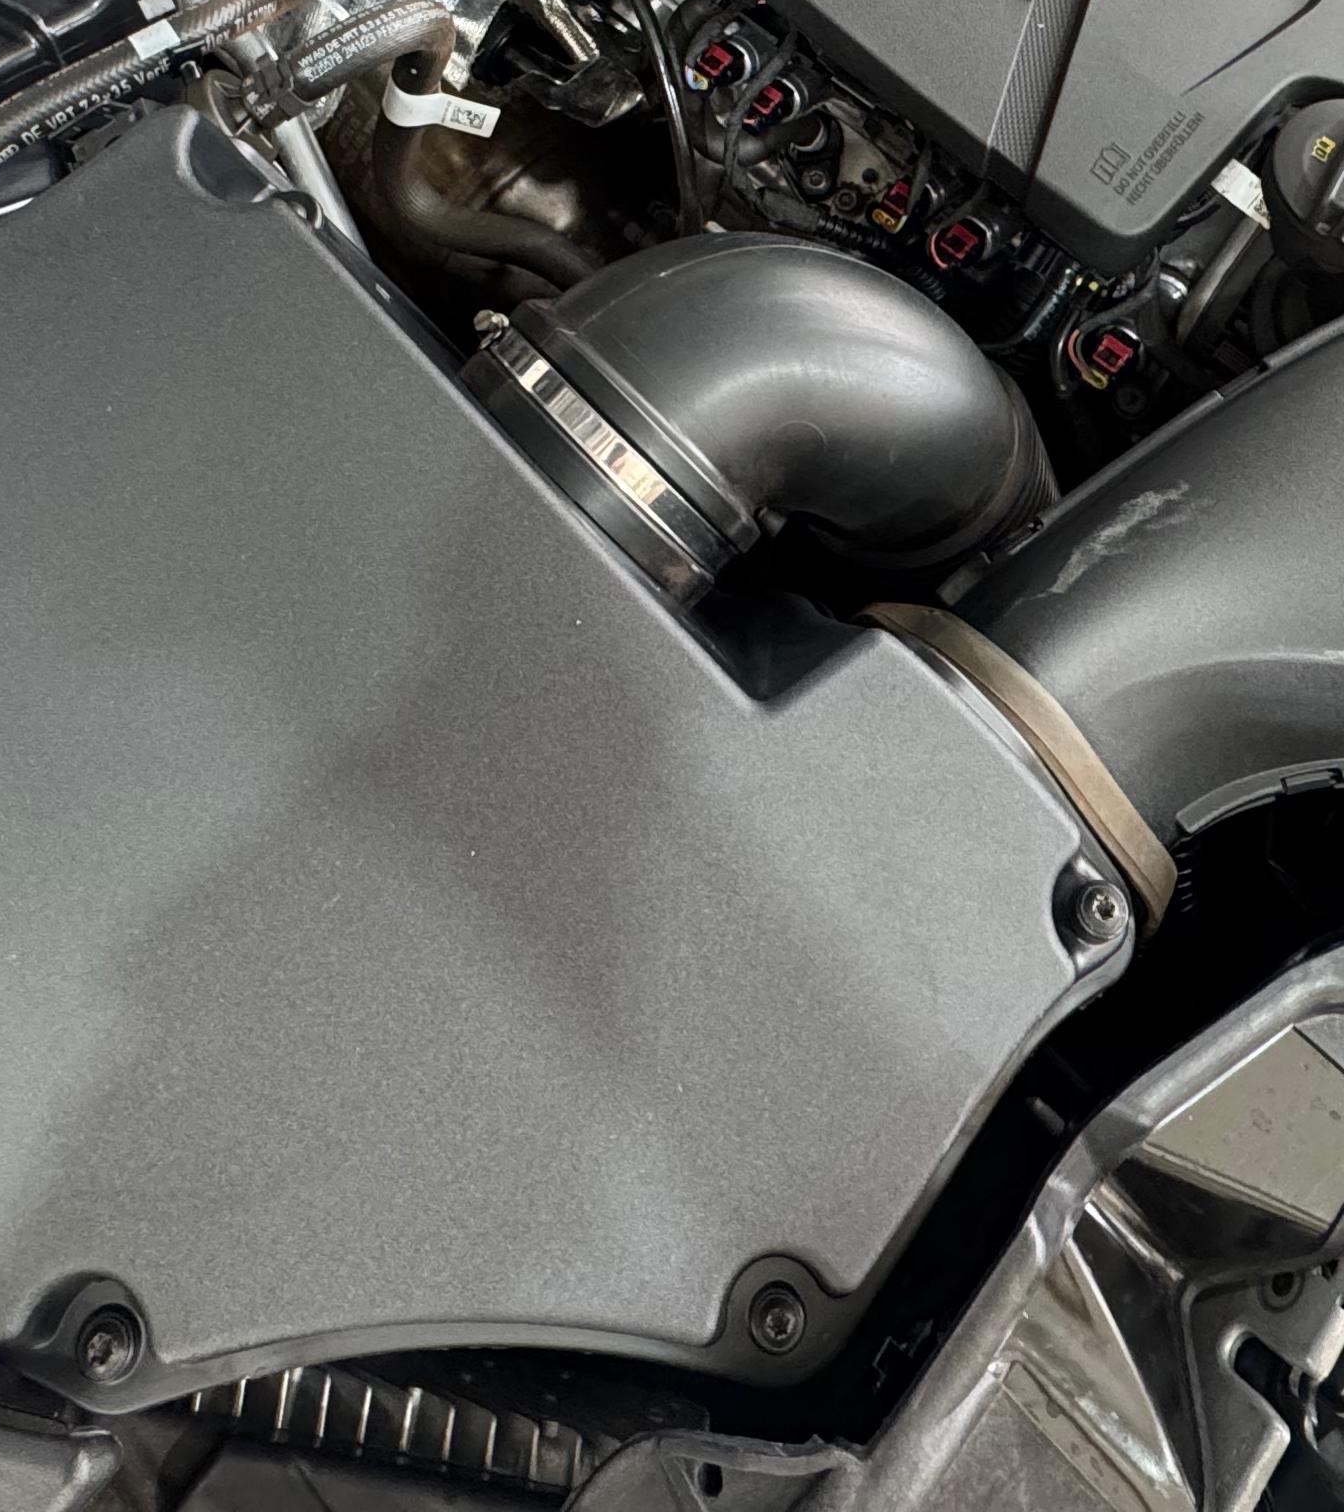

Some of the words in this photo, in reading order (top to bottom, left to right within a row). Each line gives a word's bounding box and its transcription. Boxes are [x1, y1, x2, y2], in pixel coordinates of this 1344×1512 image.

[21, 124, 41, 146] DE
[1113, 177, 1131, 197] DO
[1126, 155, 1148, 181] NOT
[1126, 171, 1155, 206] NICHT
